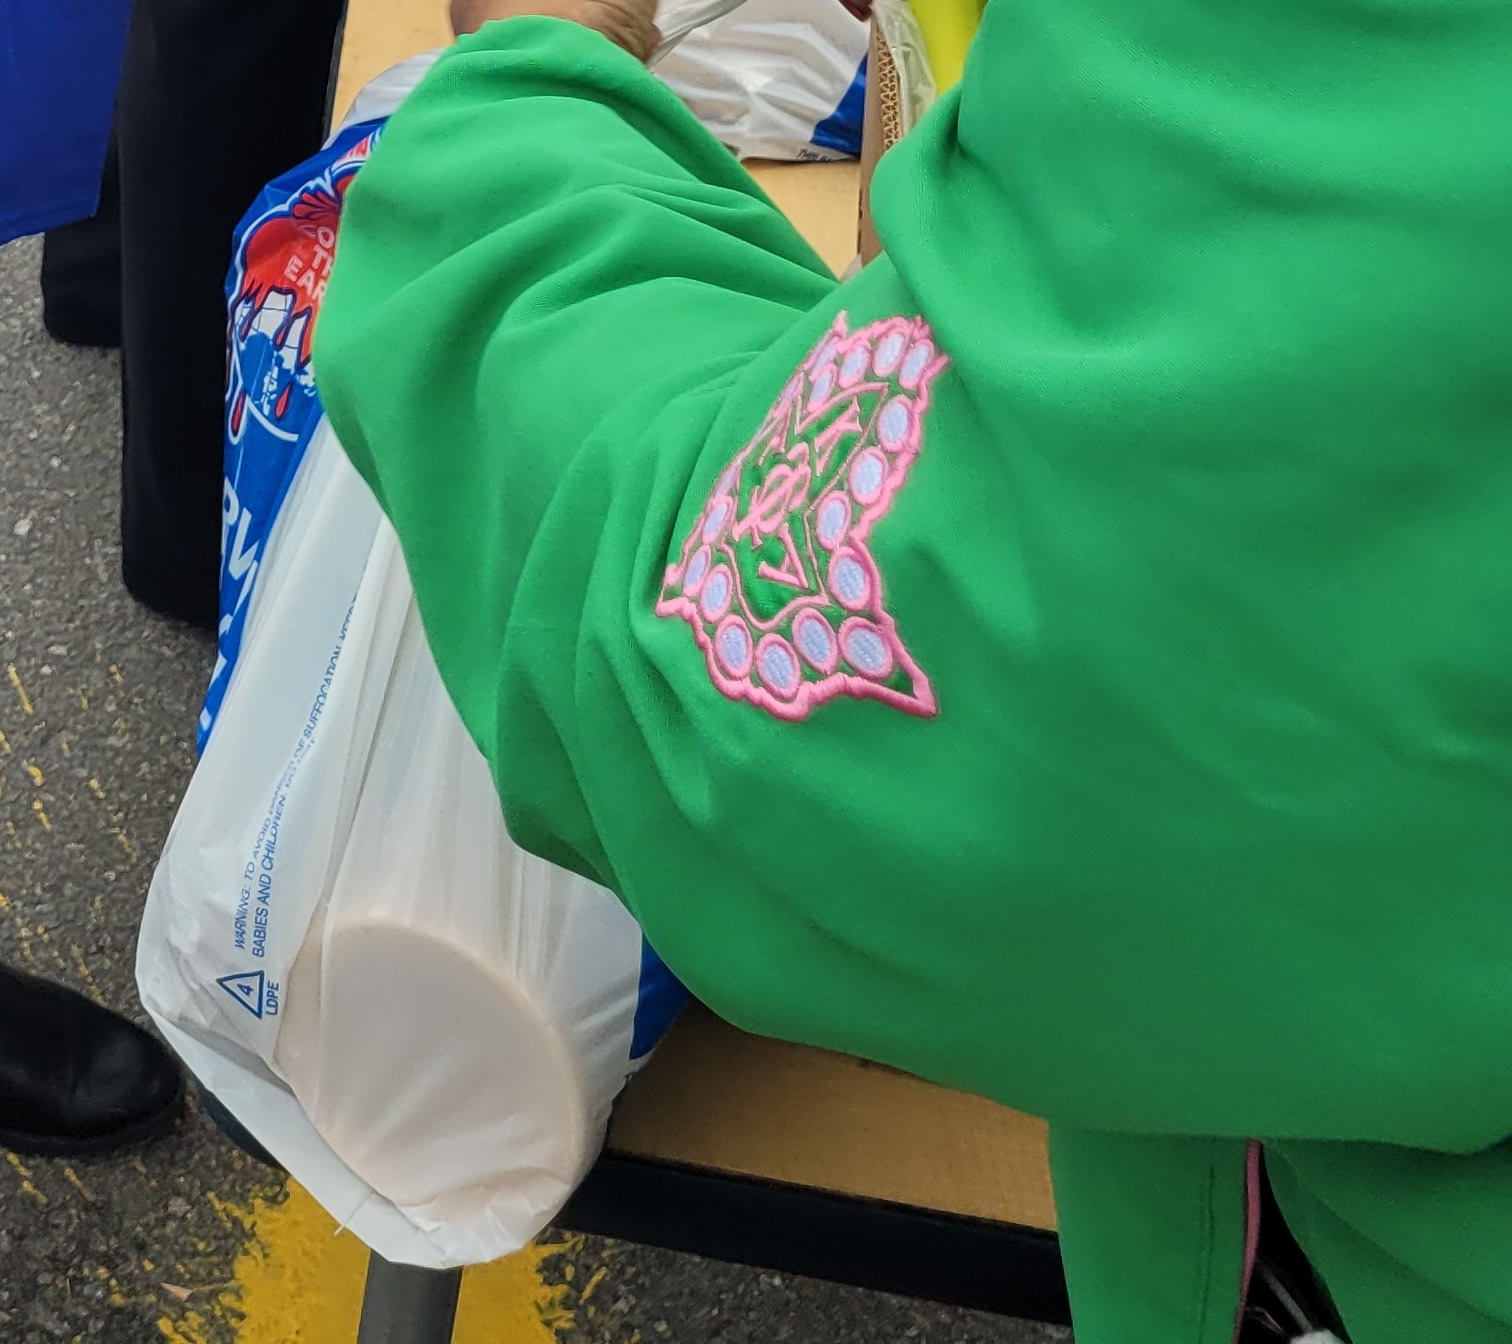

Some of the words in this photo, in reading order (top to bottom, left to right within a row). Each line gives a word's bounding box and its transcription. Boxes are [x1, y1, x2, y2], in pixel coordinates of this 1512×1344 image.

[244, 861, 255, 882] TO
[257, 872, 272, 907] AND
[251, 908, 269, 958] BABIES
[238, 982, 254, 996] 4
[265, 981, 280, 1016] LDPE
